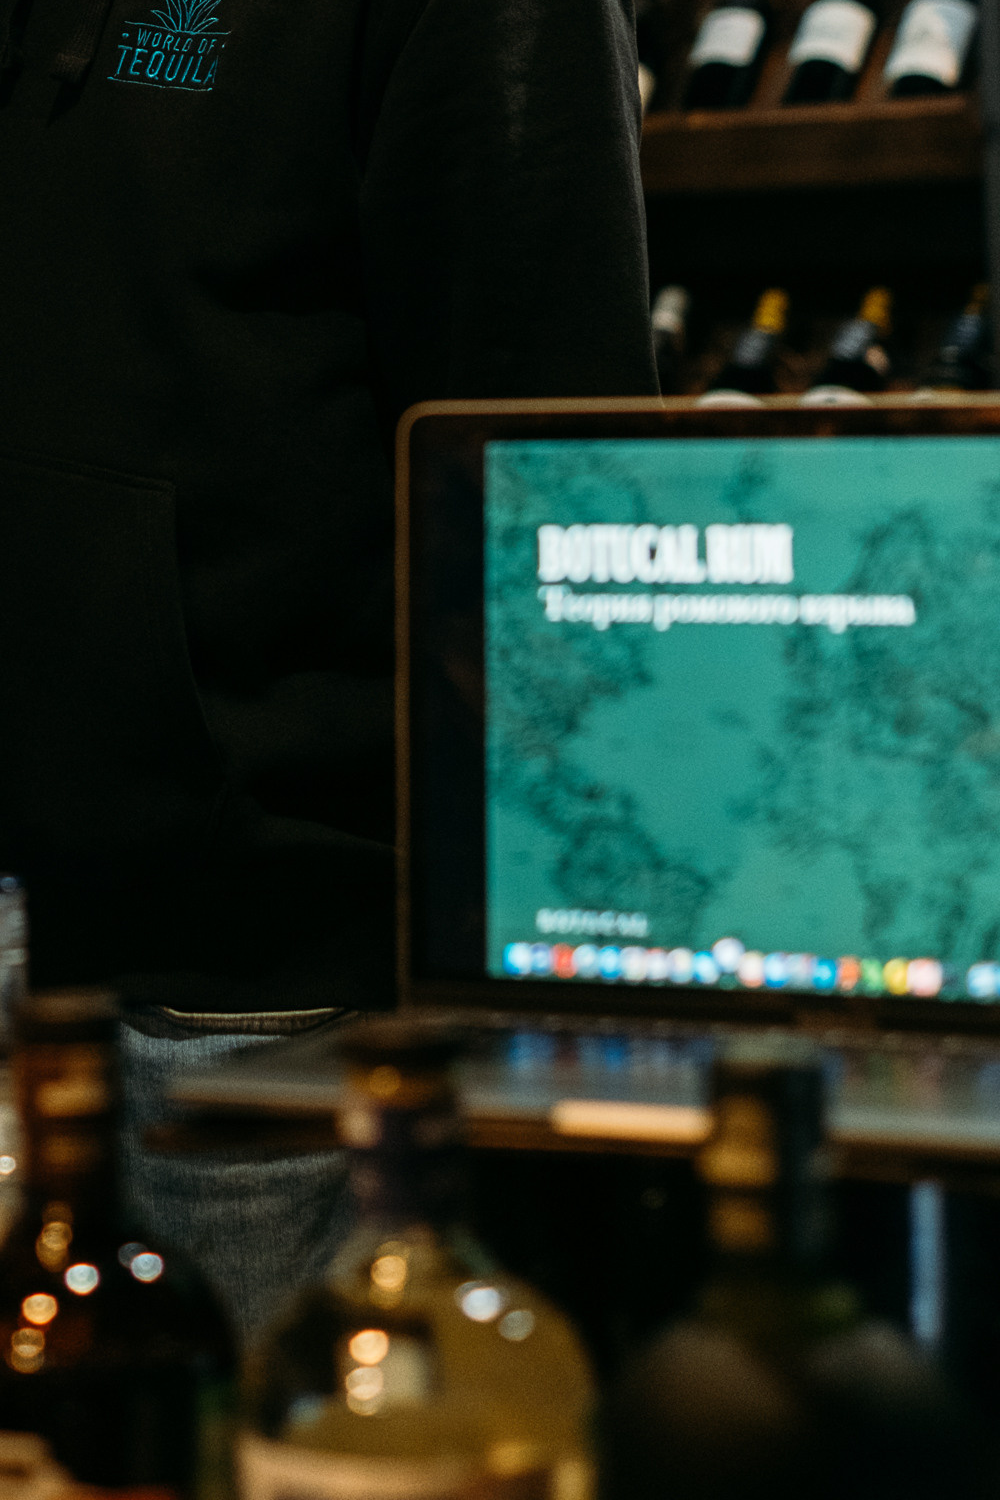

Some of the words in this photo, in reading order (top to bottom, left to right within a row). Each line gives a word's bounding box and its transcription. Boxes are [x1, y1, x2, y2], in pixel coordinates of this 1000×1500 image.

[137, 28, 193, 52] WORLD
[197, 38, 217, 54] OF
[115, 45, 219, 83] TEQUILA
[706, 523, 794, 585] RUM
